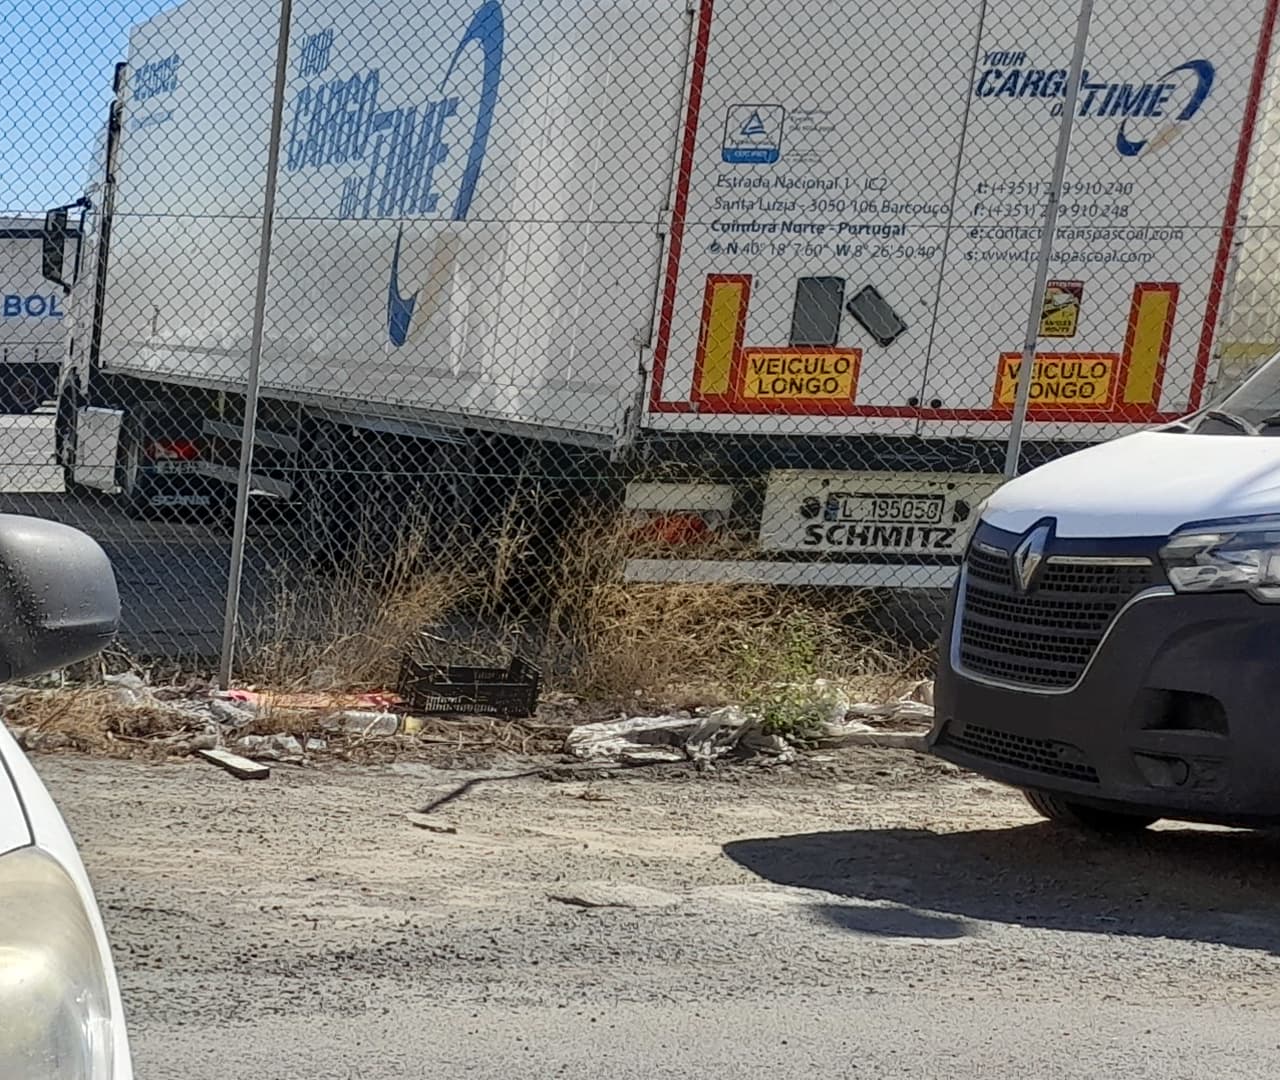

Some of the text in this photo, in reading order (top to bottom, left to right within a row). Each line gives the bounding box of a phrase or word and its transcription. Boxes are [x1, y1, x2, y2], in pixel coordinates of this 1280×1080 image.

[982, 51, 1027, 66] YOUR
[1078, 83, 1176, 117] TIME
[288, 69, 379, 172] CARGO
[363, 97, 460, 219] TIME
[716, 174, 770, 188] Estrada
[774, 174, 840, 190] Nacional
[865, 177, 888, 191] IC2
[1043, 182, 1071, 196] 29
[712, 197, 755, 211] Santa
[1040, 204, 1067, 218] 29
[711, 220, 776, 234] Coimbra
[781, 220, 825, 234] Norte
[838, 222, 906, 239] Portugal
[726, 242, 738, 255] N
[836, 244, 851, 257] W
[981, 249, 1152, 264] www.traspascoal.com
[3, 294, 64, 316] BOL
[752, 358, 850, 375] VEICULO
[758, 378, 839, 394] LONGO
[804, 524, 956, 548] SCHMITZ
